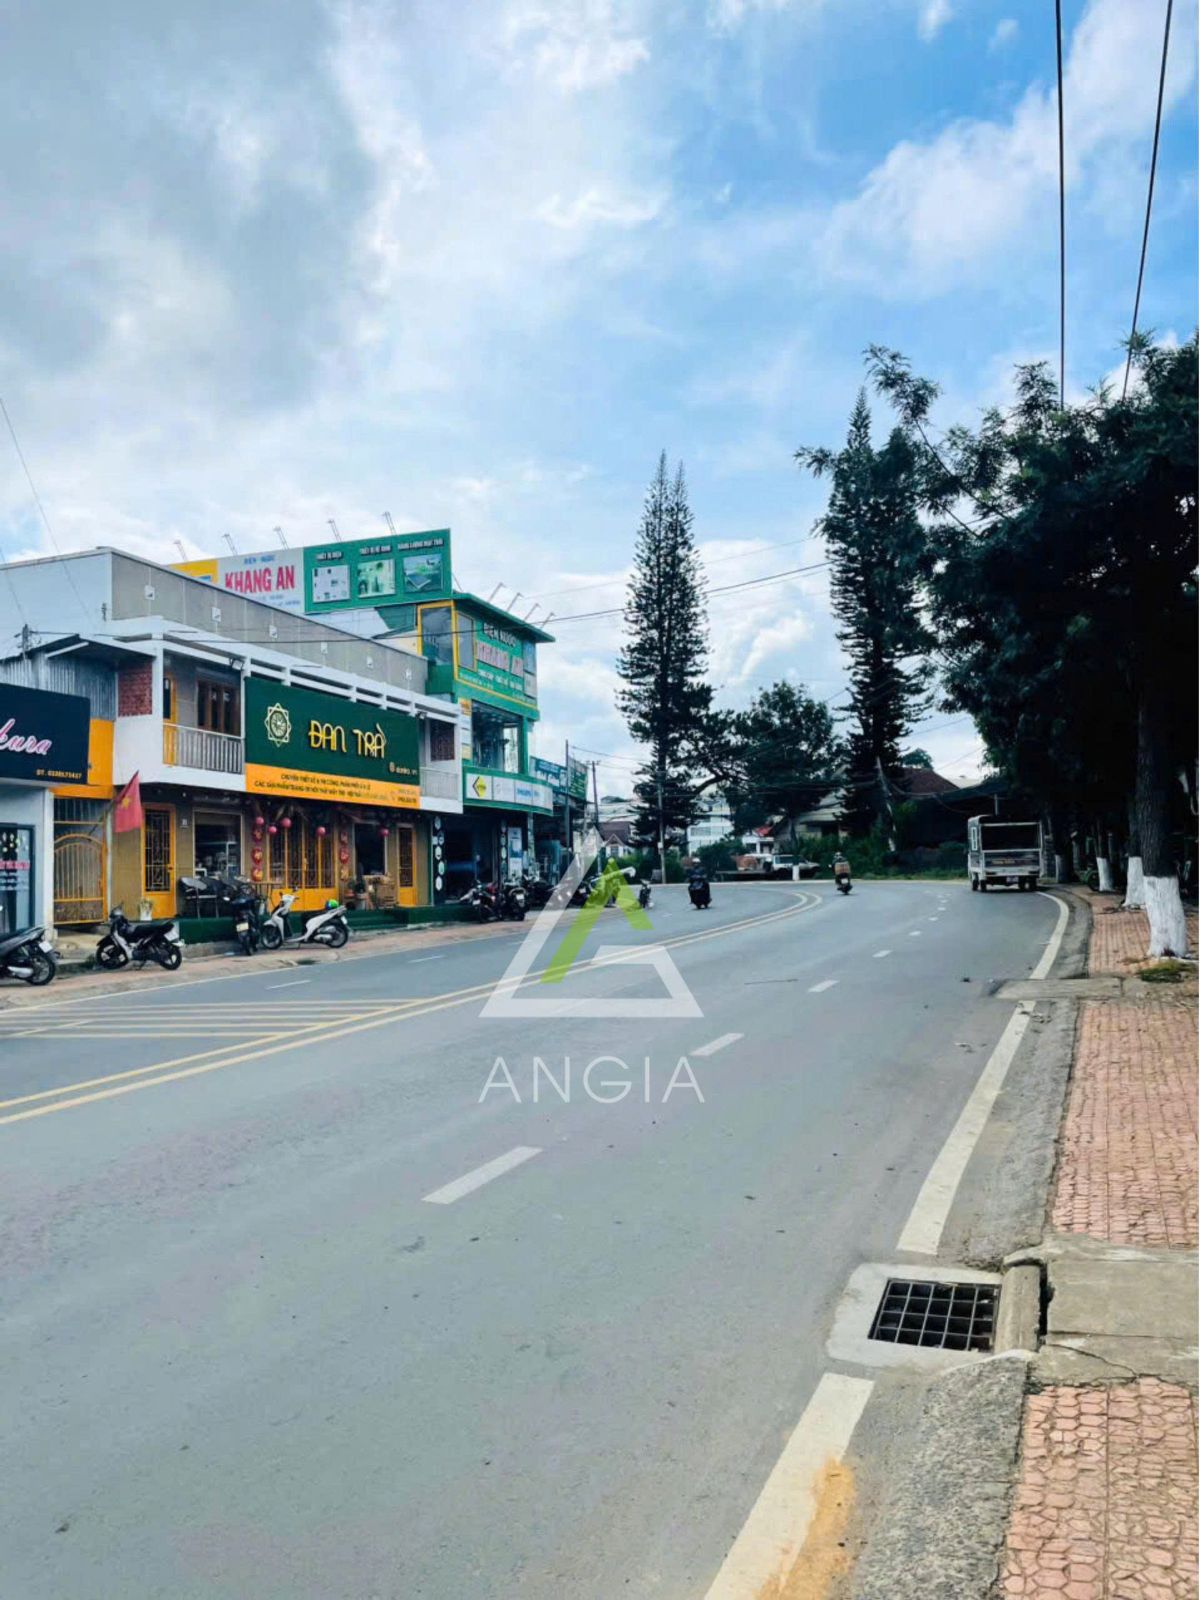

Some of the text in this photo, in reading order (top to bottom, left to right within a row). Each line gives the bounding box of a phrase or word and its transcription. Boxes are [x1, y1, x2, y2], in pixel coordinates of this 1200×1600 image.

[225, 565, 295, 594] KHANG AN
[308, 720, 387, 759] ĐAN TRÀ
